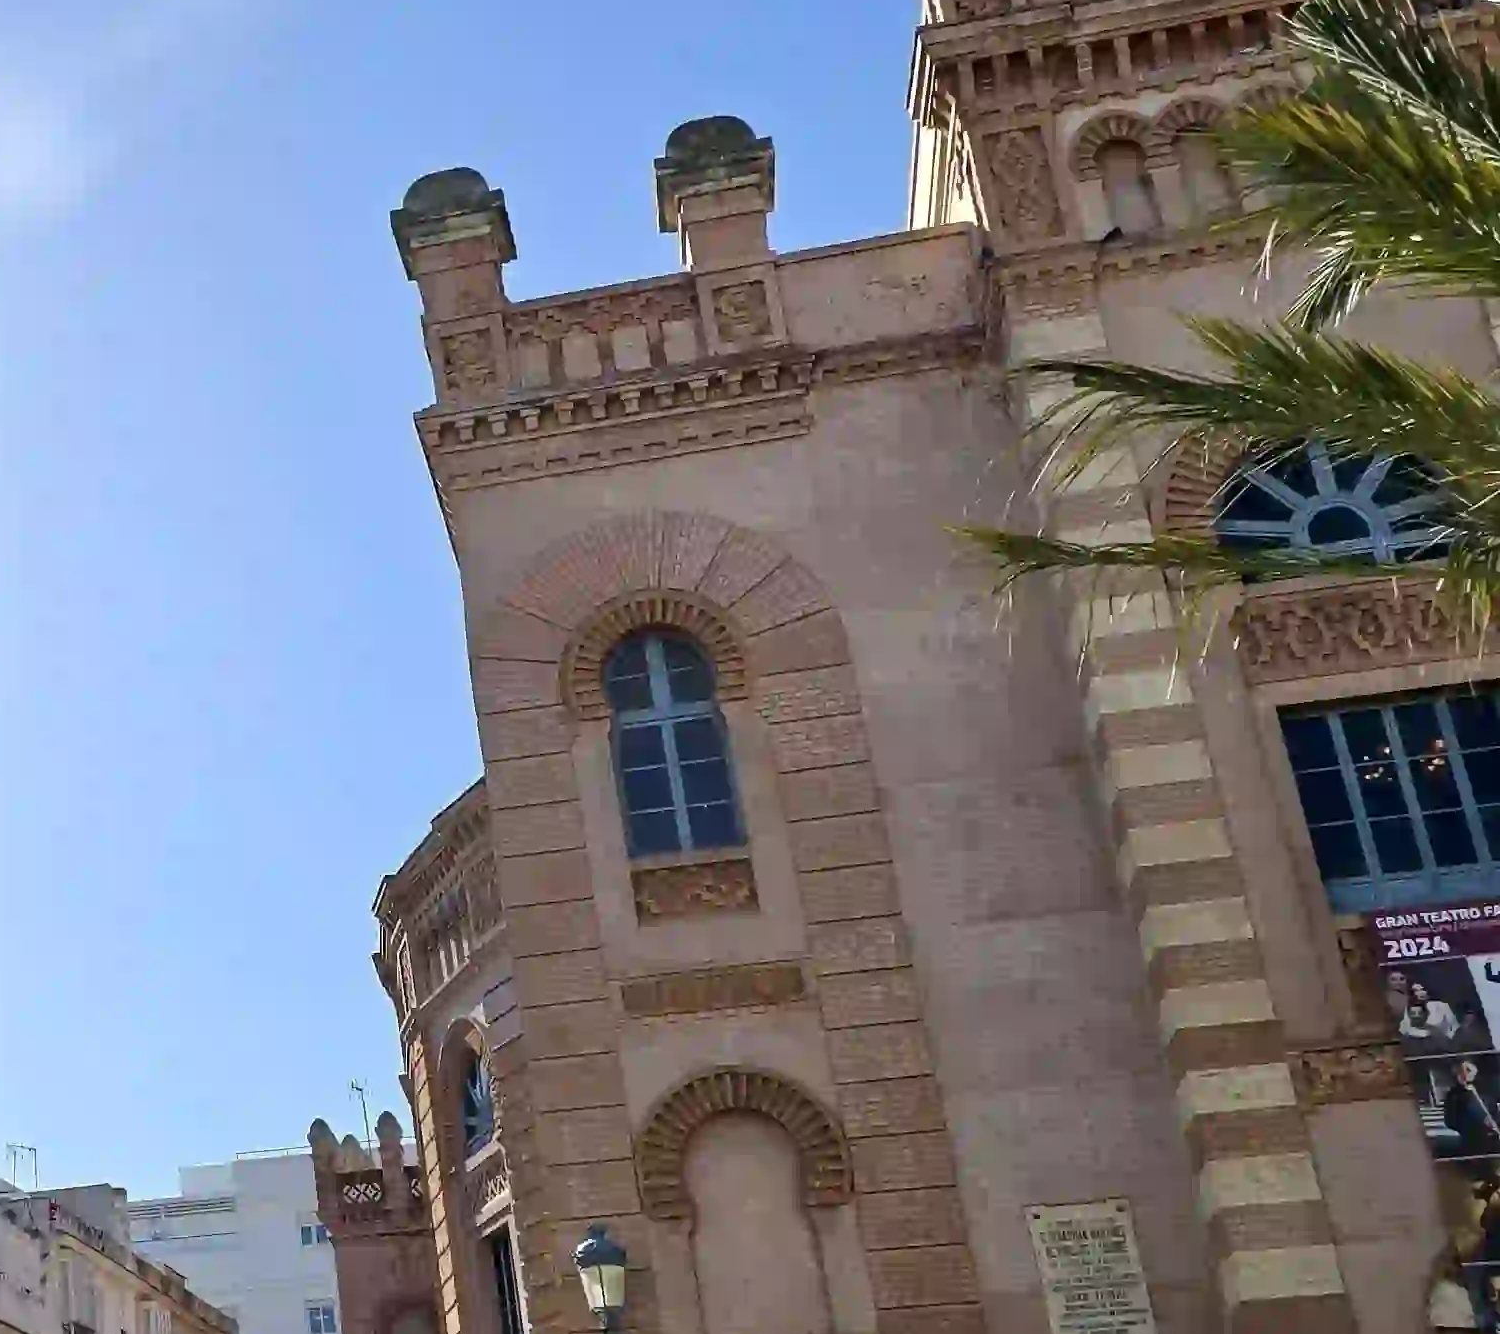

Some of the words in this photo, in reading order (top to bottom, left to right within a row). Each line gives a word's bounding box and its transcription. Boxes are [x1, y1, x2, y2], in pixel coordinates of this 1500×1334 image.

[1376, 913, 1418, 929] GRAN
[1420, 907, 1480, 924] TEATRO
[1384, 936, 1450, 958] 2024
